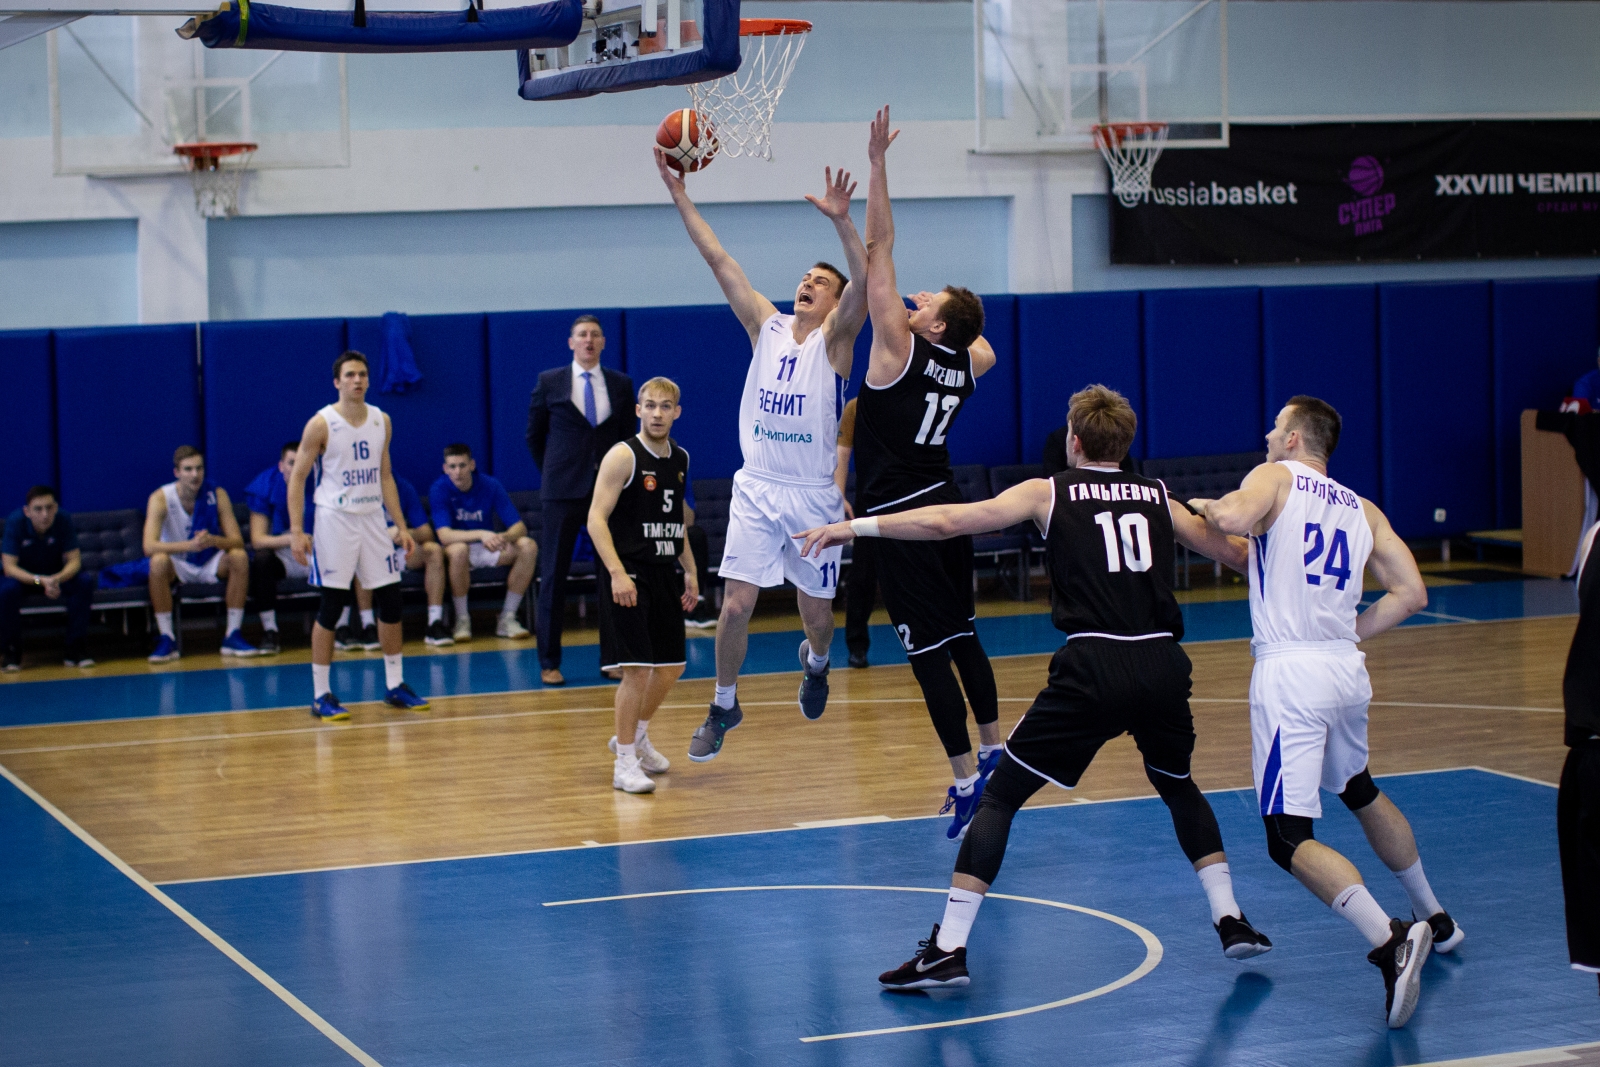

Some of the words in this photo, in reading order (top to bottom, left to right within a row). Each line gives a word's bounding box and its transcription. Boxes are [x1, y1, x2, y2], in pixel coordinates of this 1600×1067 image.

[1435, 174, 1515, 196] XXVIII
[1338, 193, 1397, 226] СУПЕР
[776, 354, 798, 382] 11
[759, 387, 807, 417] ЗЕНИТ
[914, 392, 960, 446] 12
[351, 440, 370, 461] 16
[342, 467, 379, 487] ЗЕНИТ
[662, 489, 674, 513] 5
[1068, 483, 1160, 505] ГАНЬКЕВИЧ
[1094, 511, 1153, 572] 10
[1303, 522, 1351, 591] 24
[820, 560, 837, 588] 11
[895, 623, 914, 651] 2
